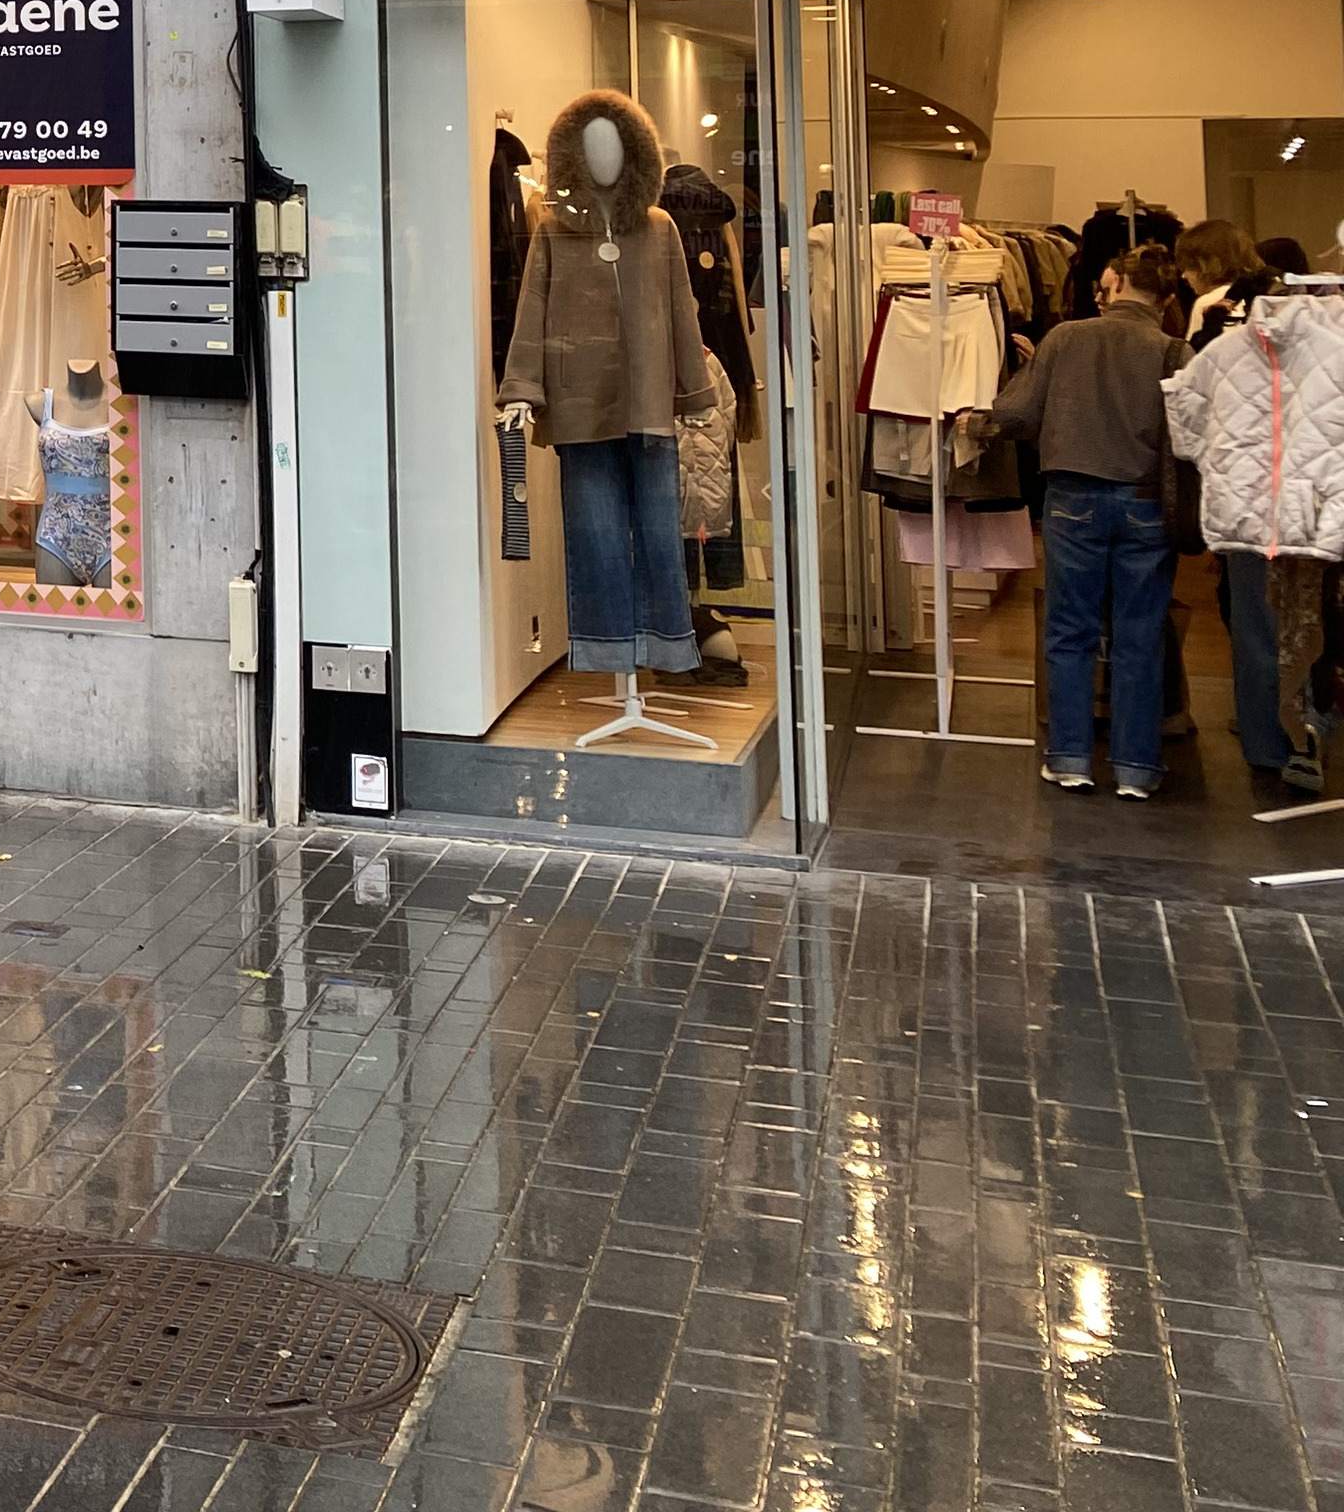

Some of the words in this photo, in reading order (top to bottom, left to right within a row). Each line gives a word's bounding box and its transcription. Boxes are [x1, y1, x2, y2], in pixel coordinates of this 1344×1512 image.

[36, 120, 69, 139] 00
[77, 120, 108, 139] 49
[911, 195, 937, 212] Last
[938, 199, 961, 215] call
[917, 216, 951, 234] -70%
